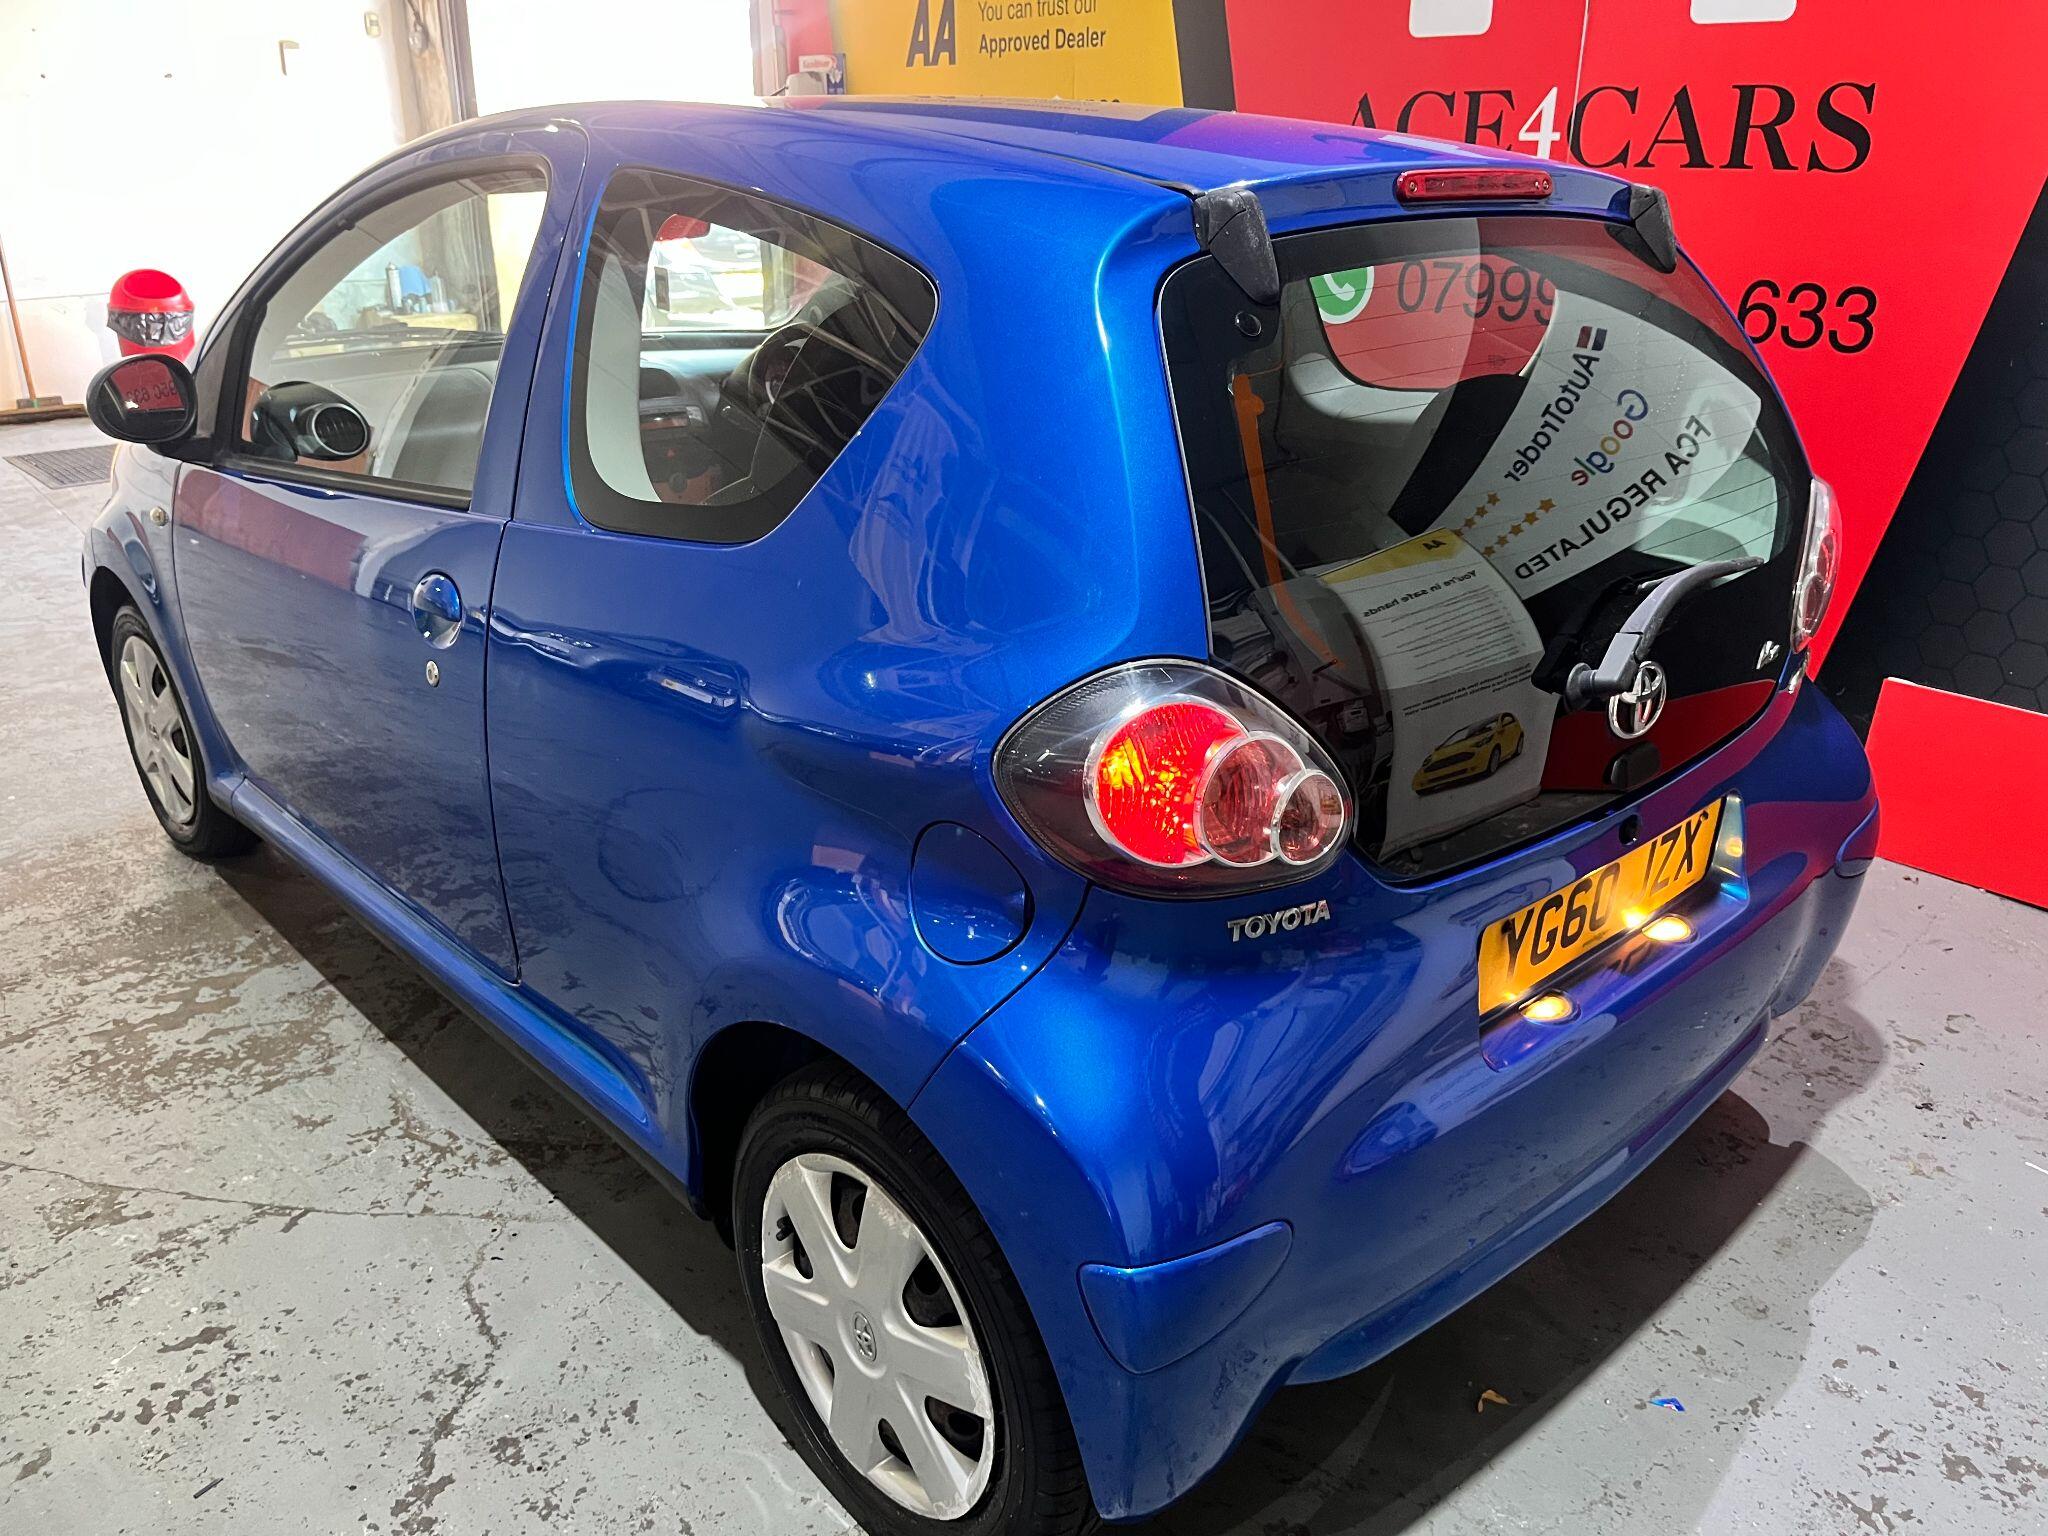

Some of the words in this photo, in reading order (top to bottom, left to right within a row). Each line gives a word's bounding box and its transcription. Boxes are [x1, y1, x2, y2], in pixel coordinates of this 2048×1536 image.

[906, 0, 956, 67] AA
[978, 1, 1003, 22] You
[1007, 2, 1033, 20] can
[1037, 0, 1069, 17] trust
[1074, 0, 1098, 14] our
[979, 28, 1050, 58] Approved
[1055, 26, 1107, 50] Dealer
[1737, 279, 1878, 354] 633
[1227, 899, 1331, 942] TOYOTA
[1504, 862, 1621, 978] YG60
